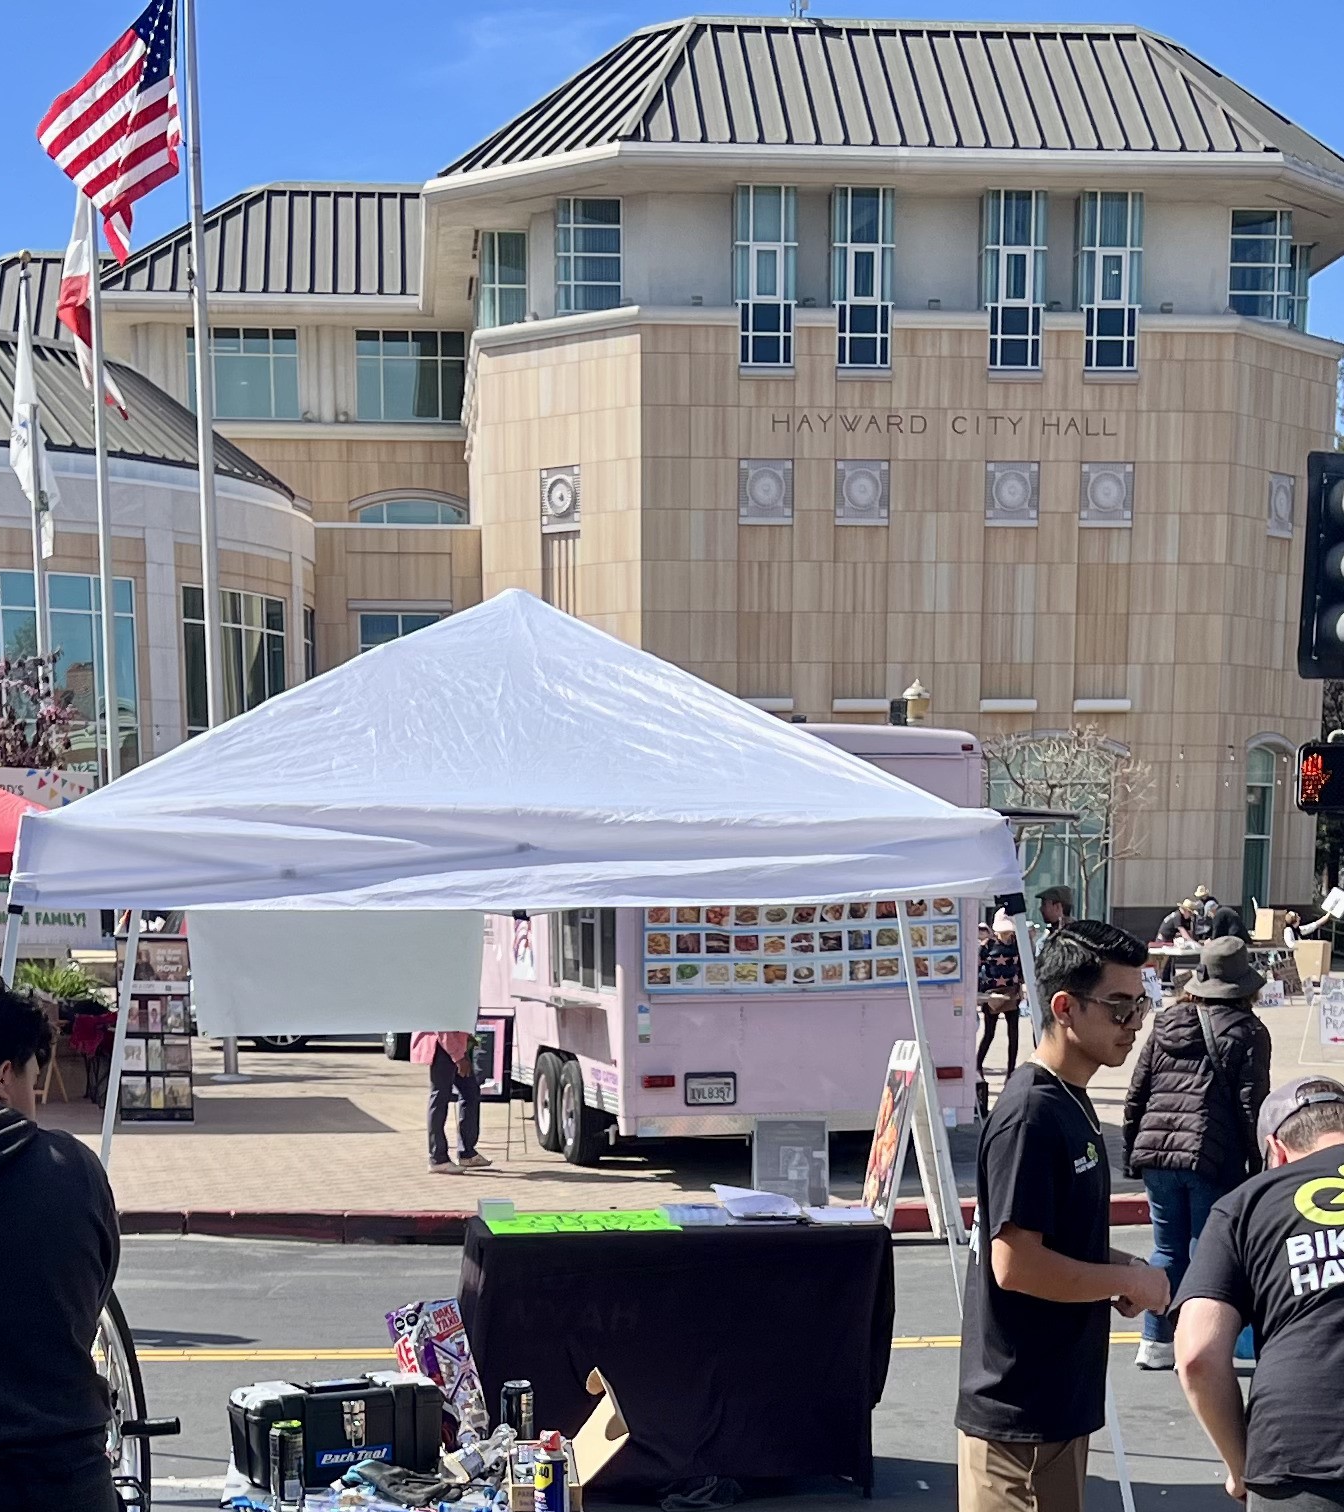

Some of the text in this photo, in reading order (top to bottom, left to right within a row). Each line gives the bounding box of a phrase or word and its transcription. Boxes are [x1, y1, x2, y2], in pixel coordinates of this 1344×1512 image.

[771, 413, 1119, 436] HAYWARD CITY HALL
[35, 909, 87, 928] FAMILY!
[320, 1447, 389, 1465] Park Tool
